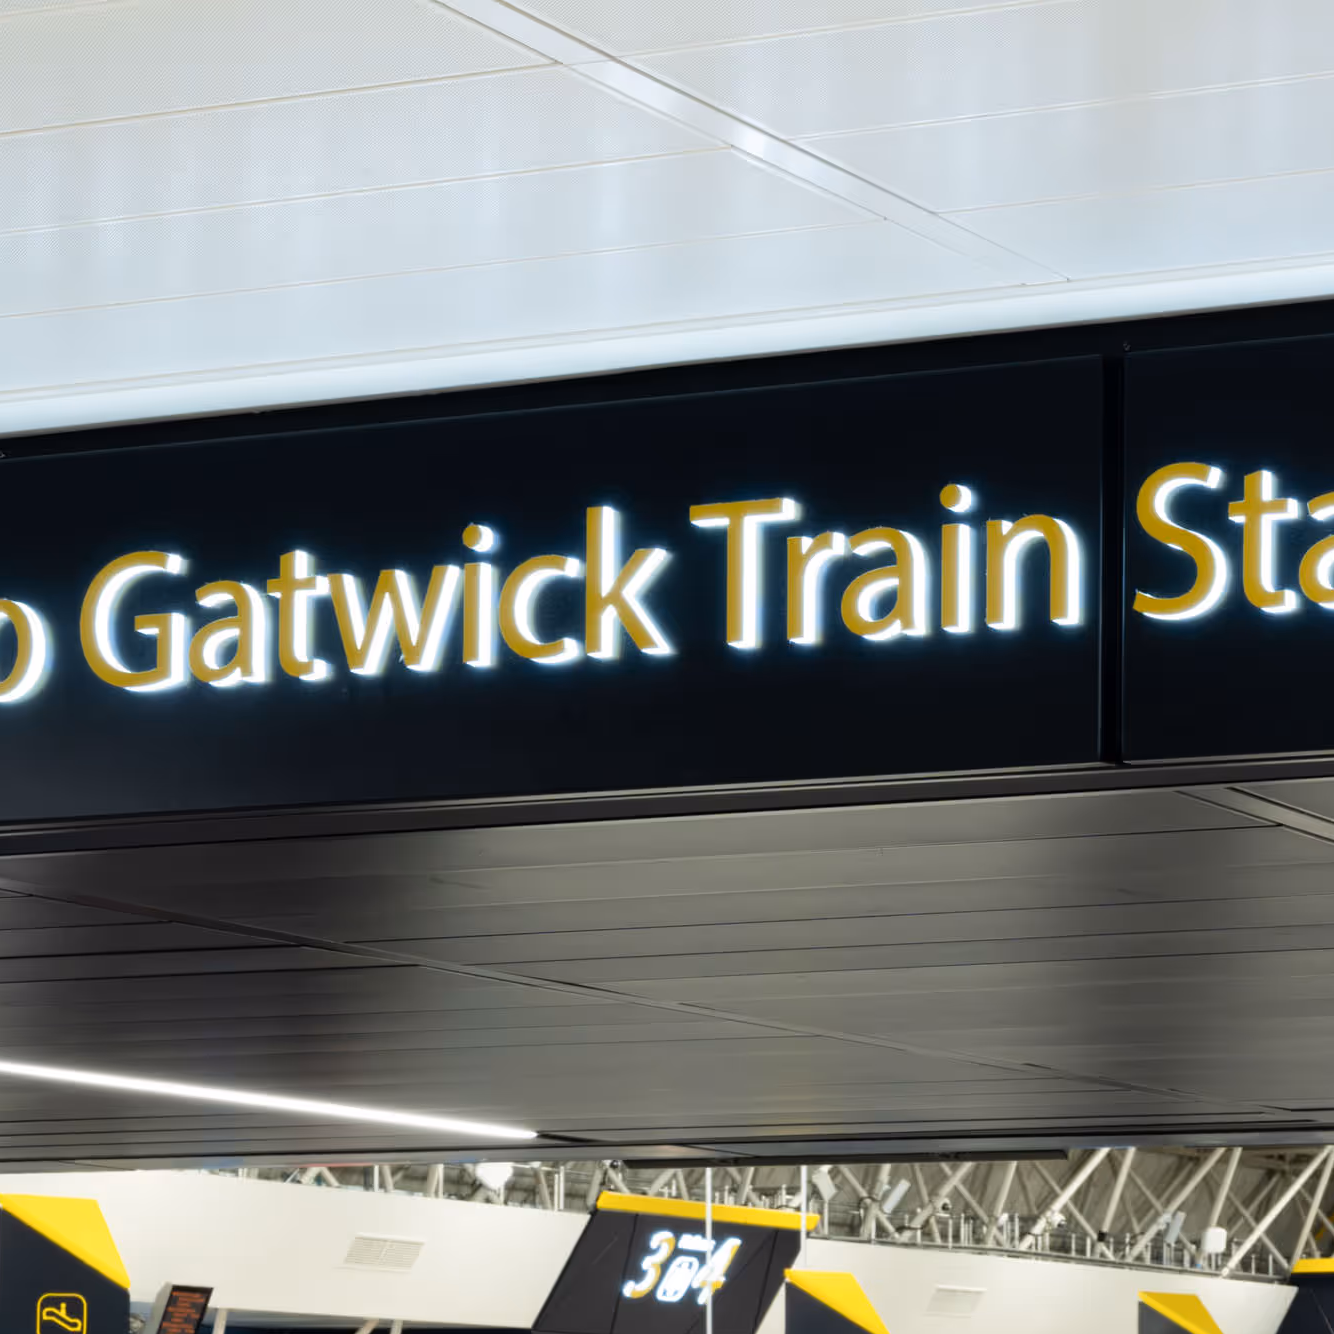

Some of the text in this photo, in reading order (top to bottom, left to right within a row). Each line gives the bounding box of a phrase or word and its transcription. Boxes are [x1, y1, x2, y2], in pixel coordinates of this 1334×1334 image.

[79, 505, 674, 693] Gatwick
[689, 483, 1085, 651] Train
[622, 1230, 743, 1305] 3 4
